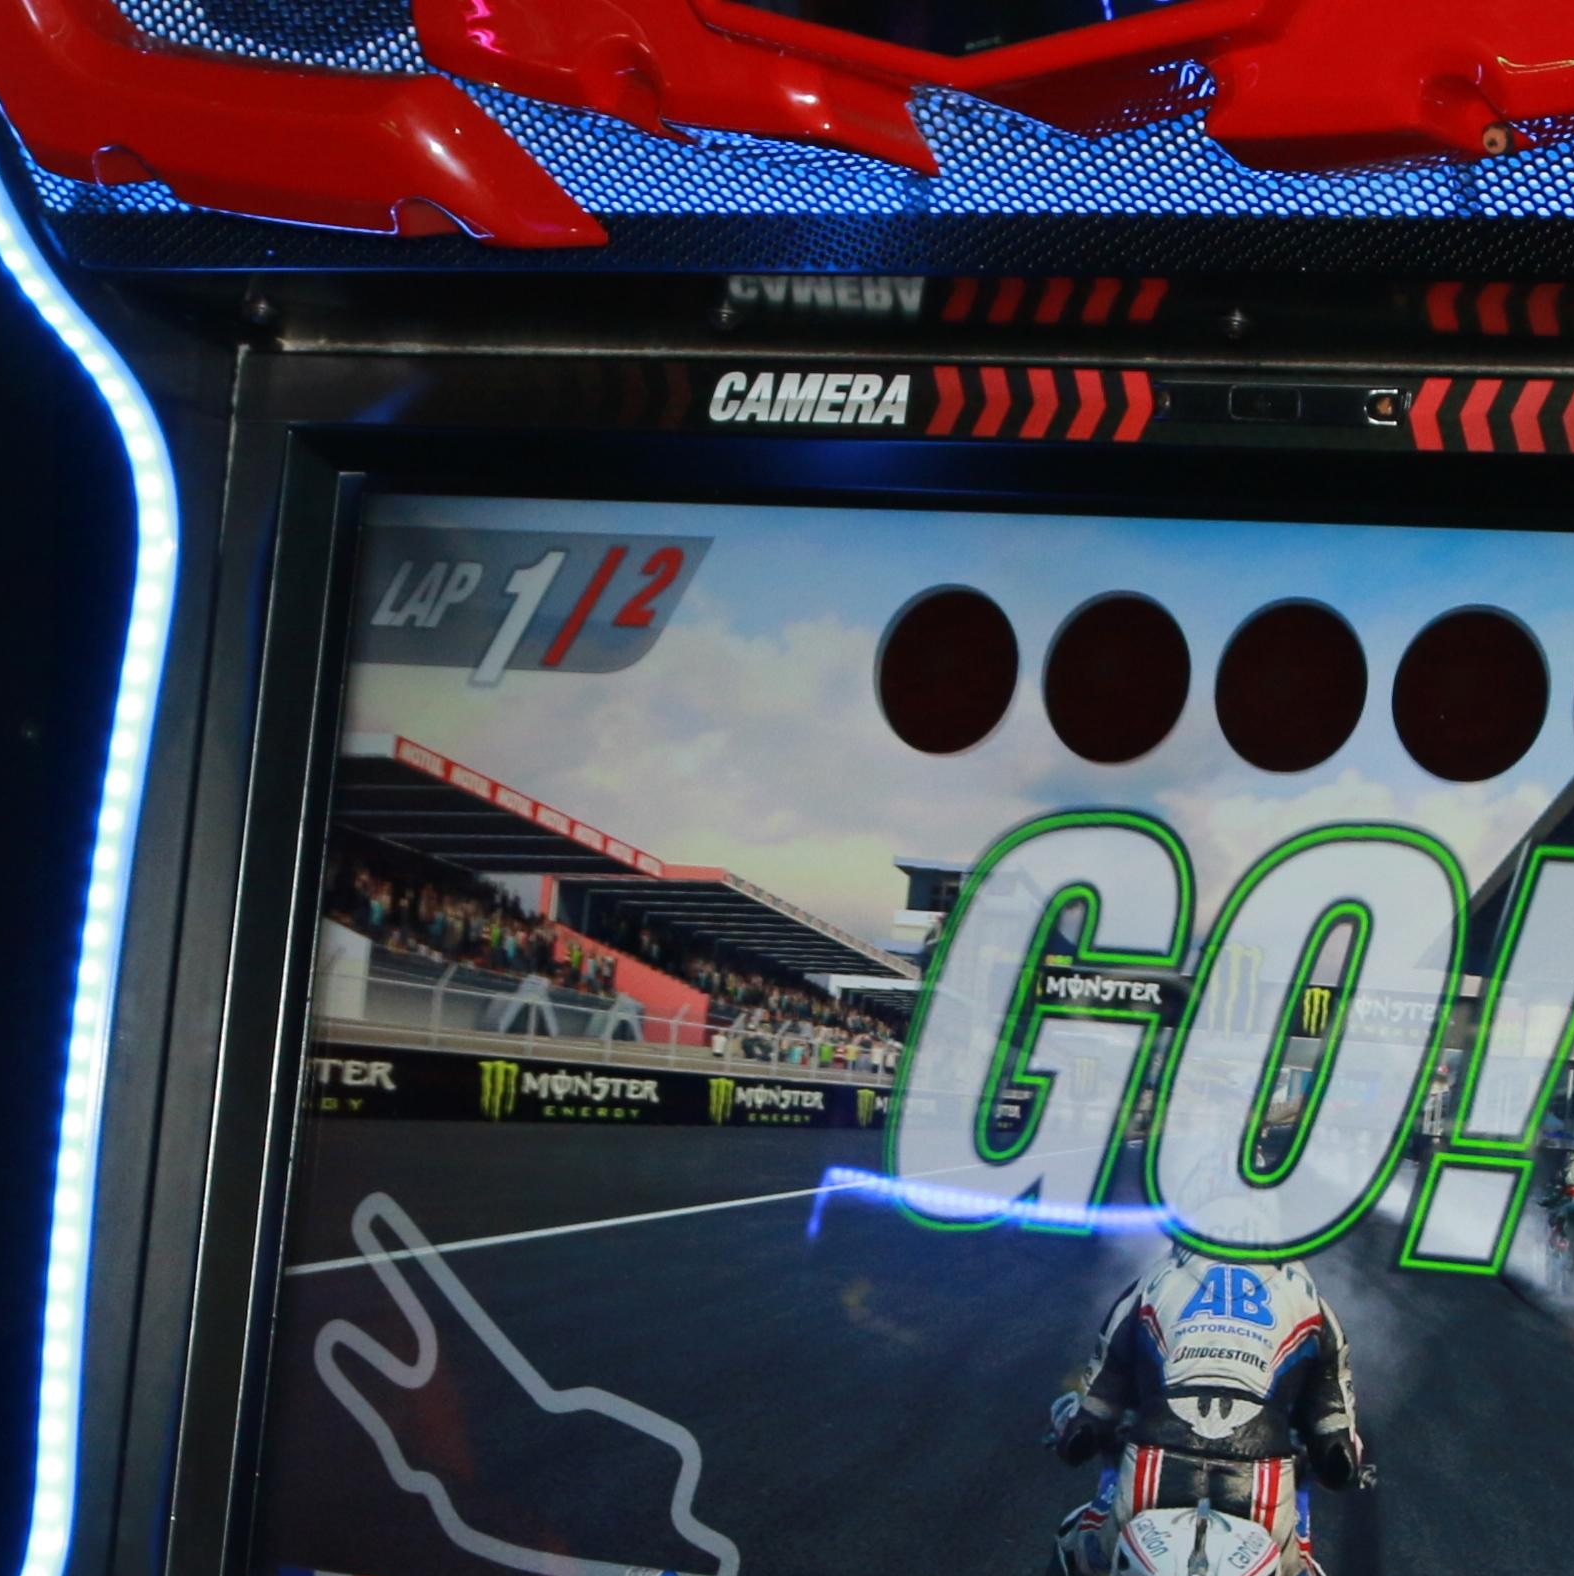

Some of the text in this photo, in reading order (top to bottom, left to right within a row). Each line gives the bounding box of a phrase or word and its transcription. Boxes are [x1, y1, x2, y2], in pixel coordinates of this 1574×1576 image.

[709, 371, 911, 425] CAMERA
[370, 560, 483, 629] LAP
[1044, 973, 1163, 1006] MONSTER
[521, 1070, 660, 1103] MONSTER
[735, 1084, 825, 1110] MONSTER
[1177, 1264, 1276, 1330] AB
[1173, 1345, 1269, 1373] BRIDGESTONE
